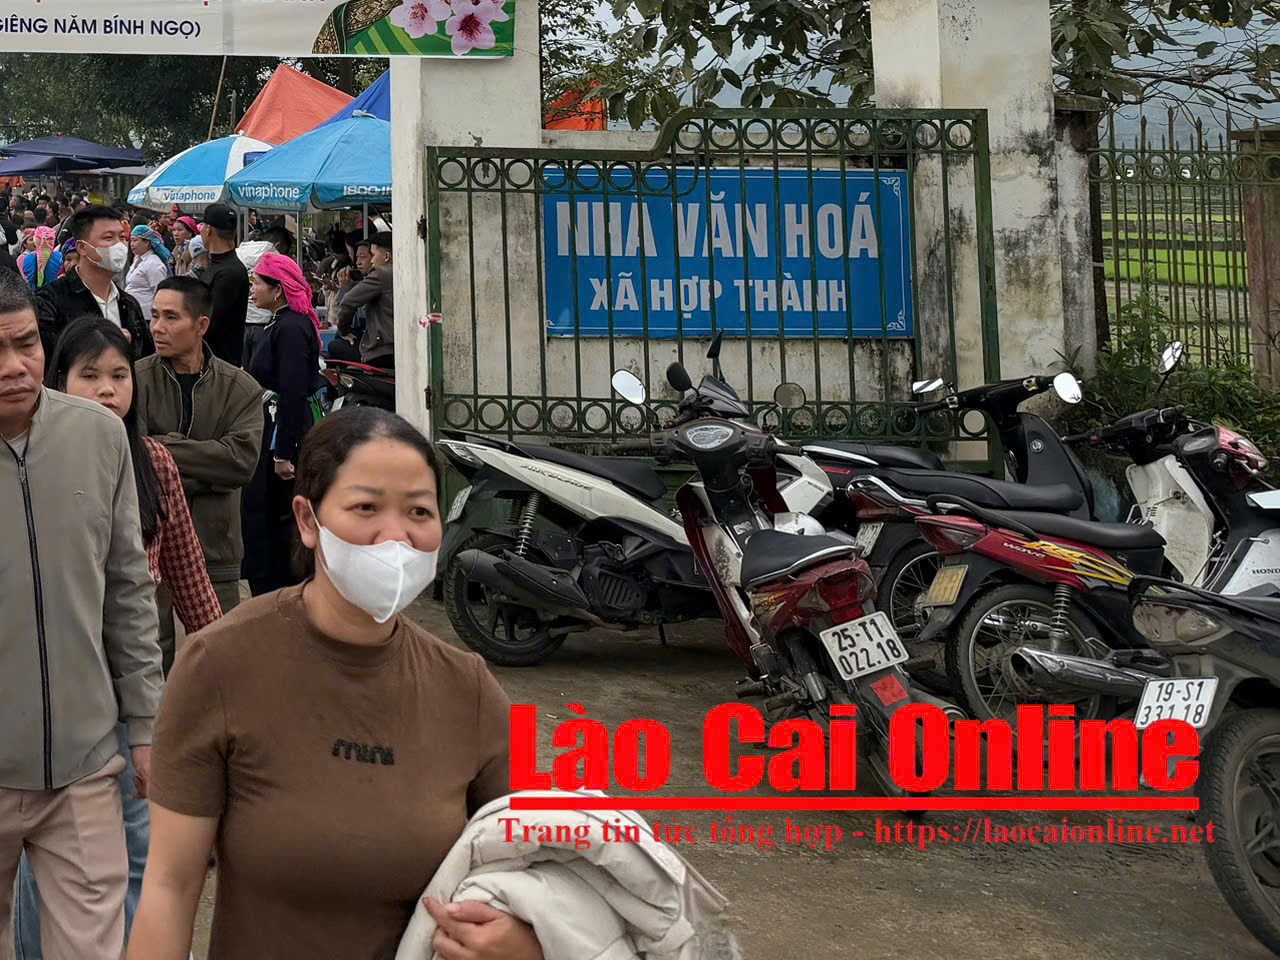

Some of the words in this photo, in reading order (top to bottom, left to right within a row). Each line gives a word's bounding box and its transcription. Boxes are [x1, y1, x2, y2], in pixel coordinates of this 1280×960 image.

[54, 13, 97, 34] NĂM
[103, 14, 144, 35] BÍNH
[150, 20, 201, 38] NGỌ)
[164, 190, 216, 202] vinaphone
[237, 183, 300, 200] vinaphone
[671, 191, 769, 258] VĂN
[784, 192, 879, 259] HOÁ
[589, 271, 640, 311] XÃ
[650, 275, 723, 319] HỢP
[733, 272, 847, 312] THÀNH
[831, 618, 884, 652] 25-T1
[838, 638, 902, 675] 022.18
[1156, 680, 1205, 703] 19-S1
